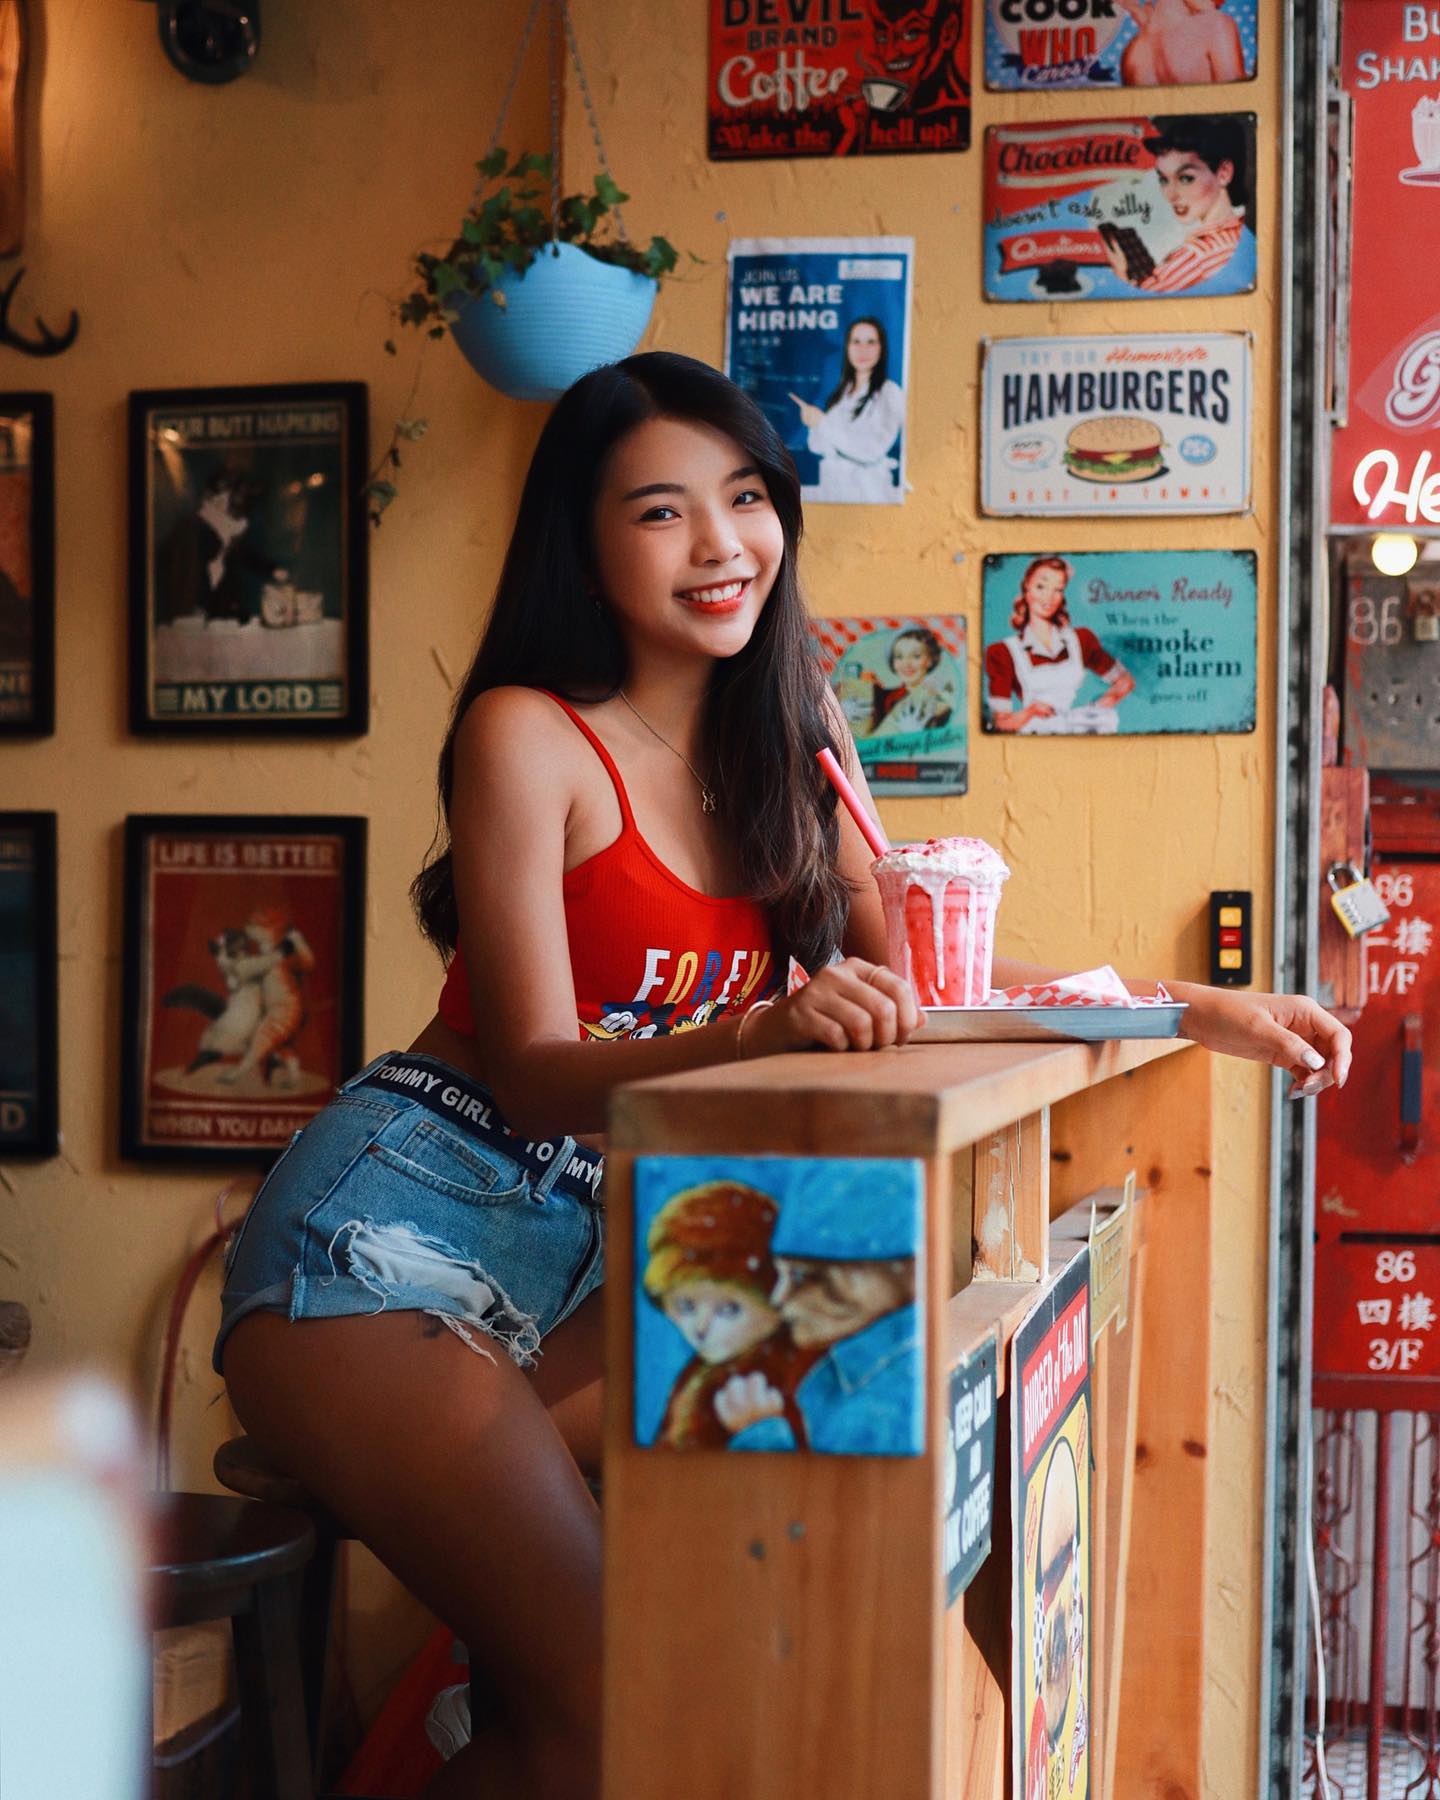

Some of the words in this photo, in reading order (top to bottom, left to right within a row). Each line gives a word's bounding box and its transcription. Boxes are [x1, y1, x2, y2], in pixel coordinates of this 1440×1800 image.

[725, 0, 864, 26] DEVIL
[748, 25, 837, 50] BRAND
[1019, 27, 1097, 67] WHO
[718, 50, 848, 112] Coffee
[794, 122, 831, 146] the
[871, 117, 914, 144] hell
[919, 117, 958, 147] up!
[999, 139, 1139, 175] Chocolate
[1112, 193, 1153, 224] silly
[740, 286, 781, 306] WE
[789, 284, 844, 305] ARE
[738, 310, 839, 331] HIRING
[1003, 369, 1229, 430] HAMBURGERS
[1171, 576, 1233, 608] Ready
[1106, 613, 1148, 626] When
[1155, 612, 1178, 625] the
[1350, 596, 1404, 645] 86
[1122, 628, 1214, 655] smoke
[1157, 655, 1242, 679] alarm
[183, 686, 228, 711] MY
[237, 685, 314, 710] LORD
[1151, 690, 1184, 705] goes
[1187, 688, 1208, 702] off
[214, 844, 236, 865] IS
[1375, 874, 1414, 907] 86
[1370, 961, 1420, 995] 1/F
[376, 1064, 443, 1094] TOMMY
[441, 1086, 493, 1130] GIRL
[216, 1118, 256, 1137] YOU
[1375, 1250, 1416, 1284] 86
[1357, 1291, 1437, 1331] 四樓
[1368, 1338, 1424, 1371] 3/F
[1024, 1349, 1054, 1454] BURGER
[1060, 1320, 1073, 1382] the
[1073, 1304, 1087, 1375] DAY
